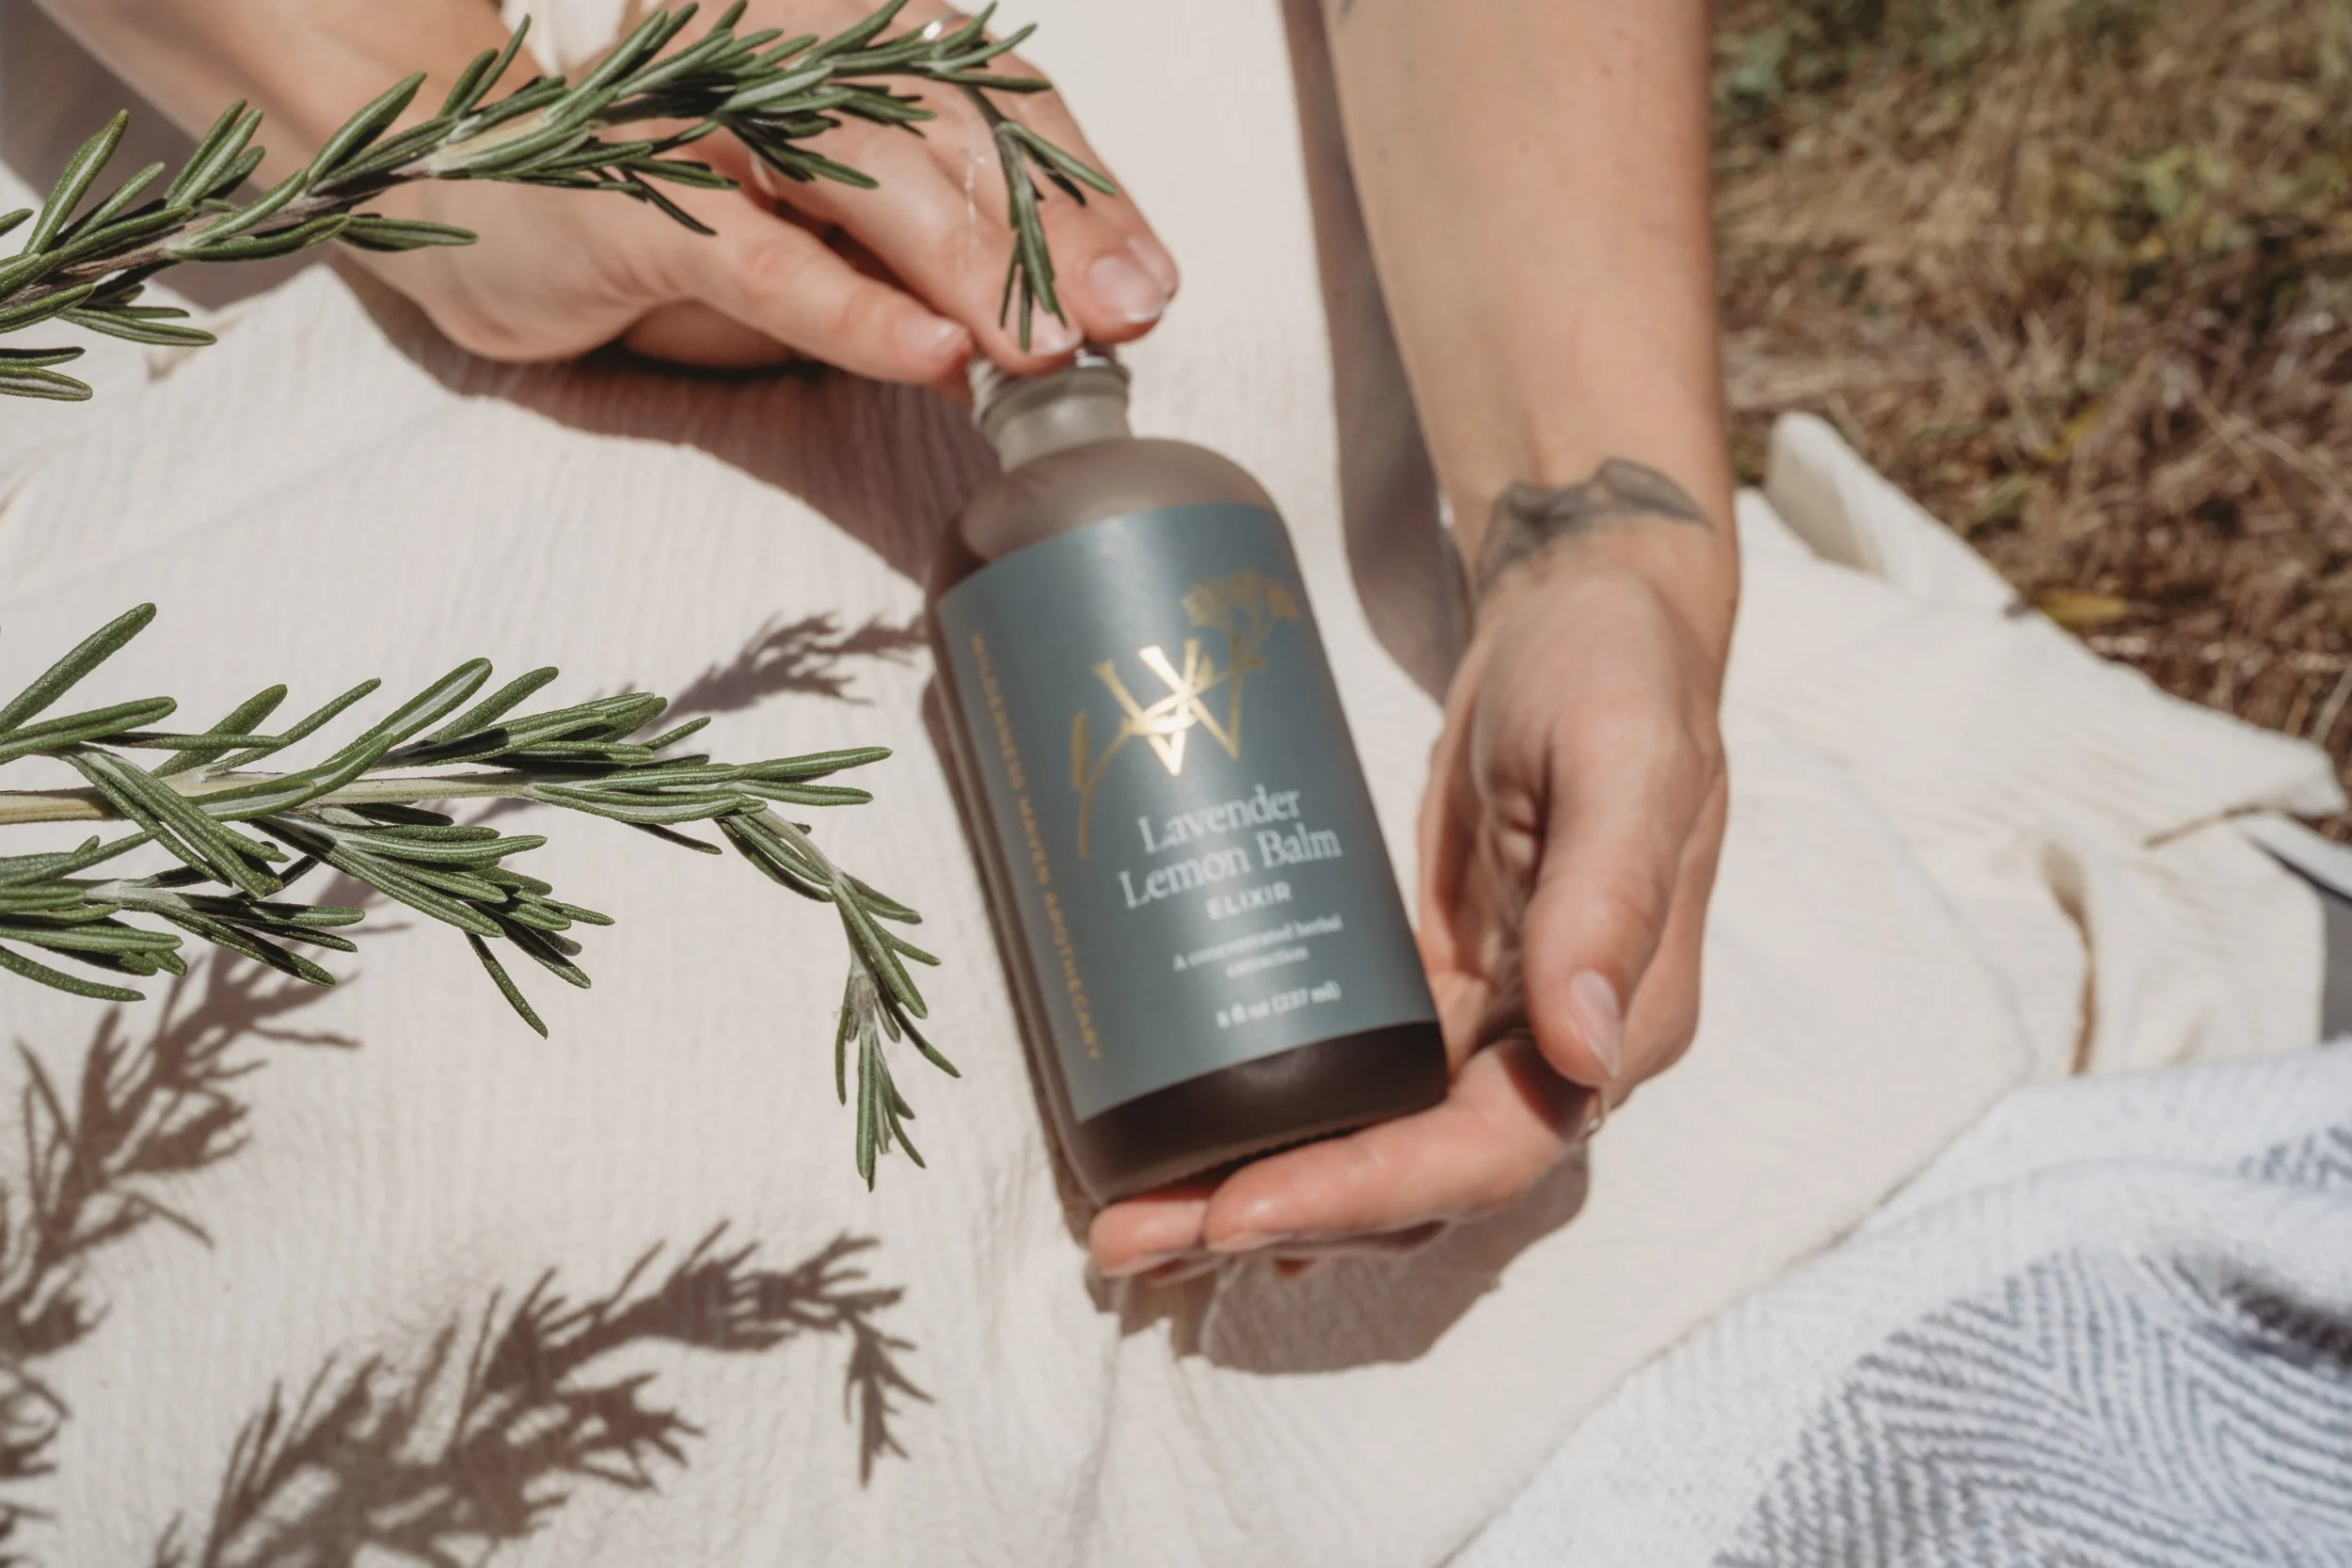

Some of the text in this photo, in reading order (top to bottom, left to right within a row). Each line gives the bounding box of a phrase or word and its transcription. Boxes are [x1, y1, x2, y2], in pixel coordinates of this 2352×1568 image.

[1136, 783, 1302, 854] Lavender
[1118, 821, 1343, 910] Lemon Balm
[1017, 795, 1051, 885] MAVEN
[1043, 892, 1103, 1059] APOTHECARY
[1205, 880, 1293, 921] ELIXIR
[1173, 953, 1188, 973] A
[1294, 912, 1344, 939] herbal
[1310, 979, 1342, 1004] ml)
